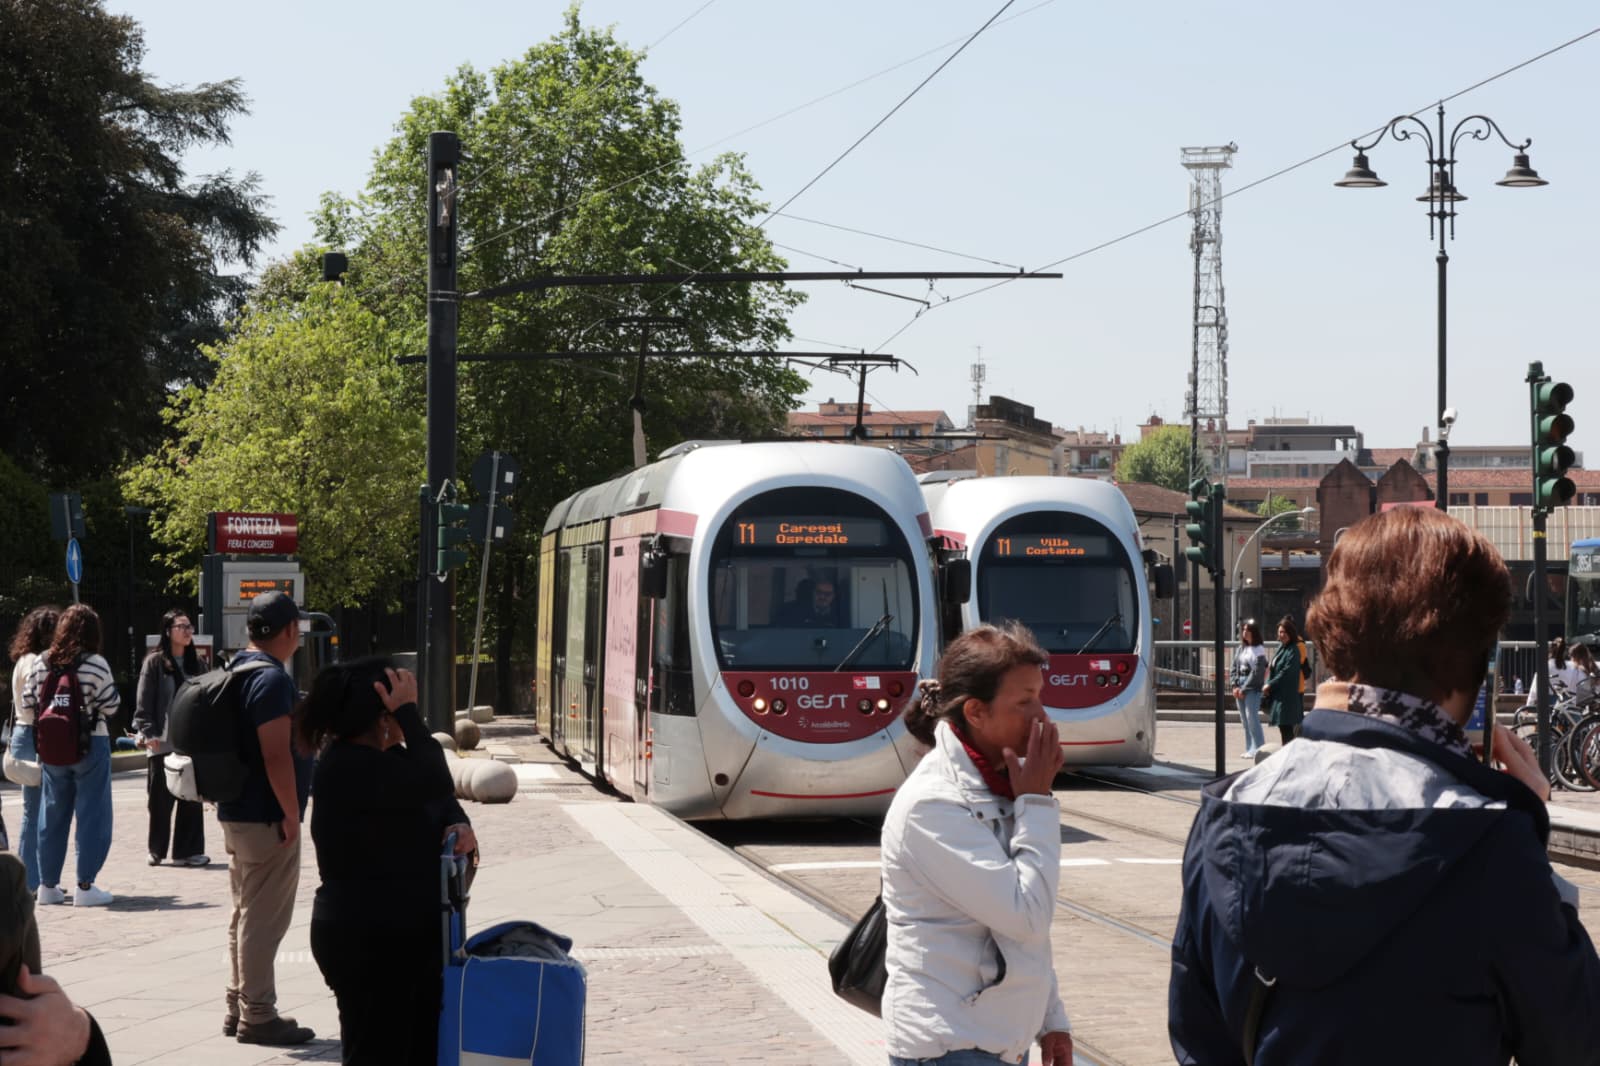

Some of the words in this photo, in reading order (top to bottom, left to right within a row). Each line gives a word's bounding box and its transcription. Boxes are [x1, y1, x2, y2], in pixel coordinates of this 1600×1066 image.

[227, 517, 281, 535] FORTEZZA
[780, 523, 842, 533] Careggi
[739, 523, 755, 544] T1
[227, 539, 242, 549] FIERA
[247, 539, 275, 549] CONGRESSI
[997, 538, 1011, 555] T1
[1040, 538, 1069, 546] Villa
[1026, 547, 1085, 555] Costanza
[770, 677, 809, 690] 1010
[1049, 674, 1088, 686] GEST
[50, 694, 70, 707] NS
[797, 694, 849, 709] GEST
